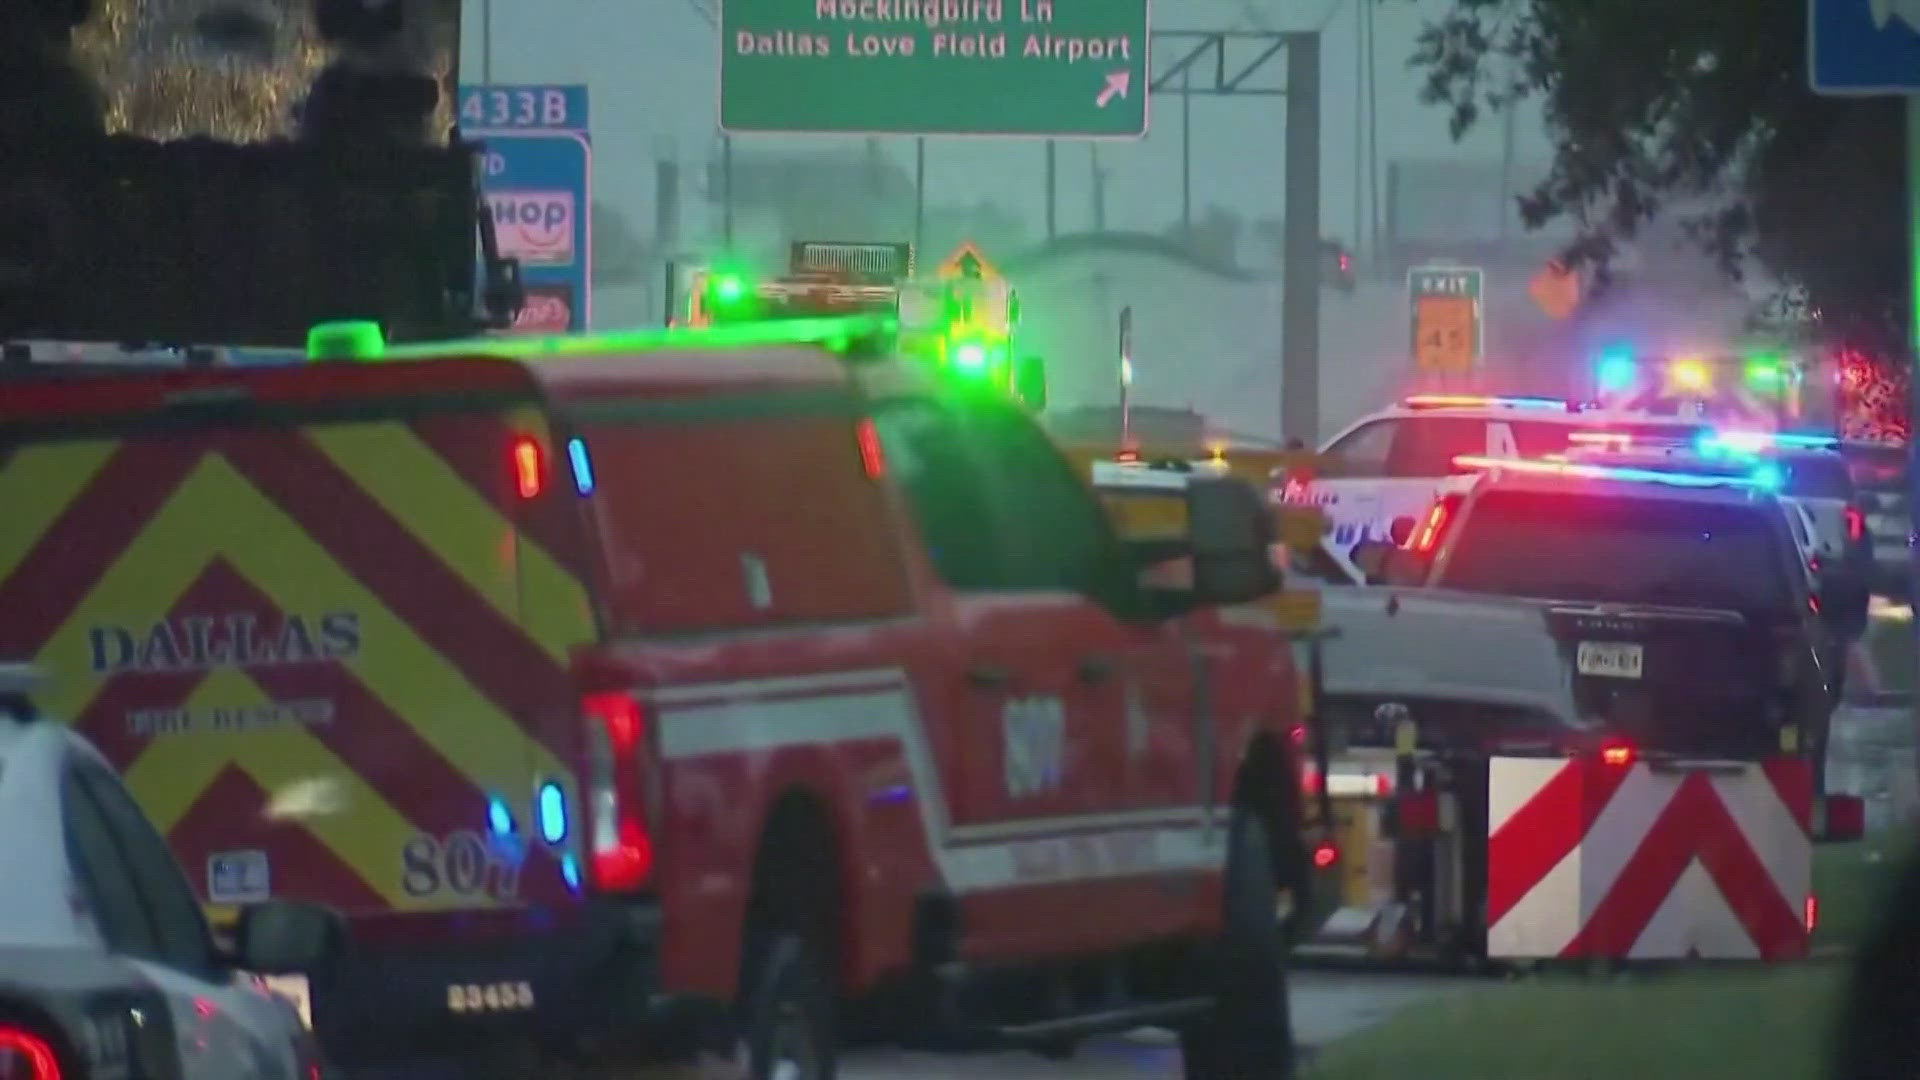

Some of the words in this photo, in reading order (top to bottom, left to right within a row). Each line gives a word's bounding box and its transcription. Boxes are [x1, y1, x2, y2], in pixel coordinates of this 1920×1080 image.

[816, 0, 1003, 27] Mockingbird
[1021, 0, 1053, 23] Ln
[737, 31, 831, 56] Dallas
[847, 33, 915, 56] Love
[934, 34, 1006, 58] Field
[1023, 34, 1130, 63] Airport
[461, 91, 568, 125] 433B
[1422, 277, 1467, 294] EXIT
[90, 613, 359, 672] DALLAS
